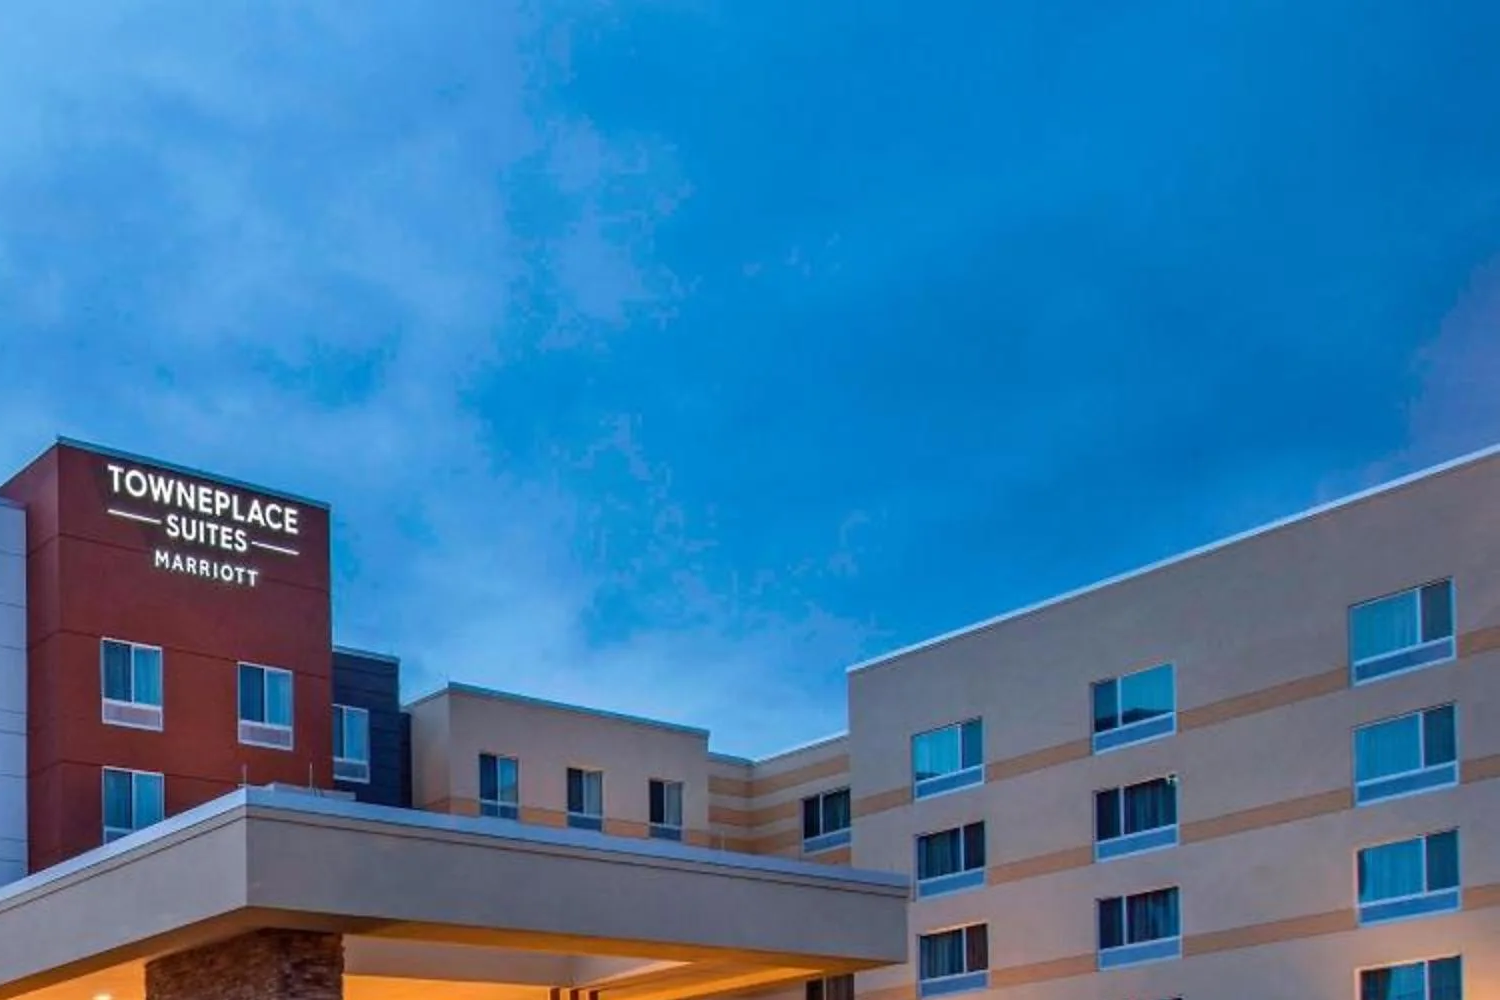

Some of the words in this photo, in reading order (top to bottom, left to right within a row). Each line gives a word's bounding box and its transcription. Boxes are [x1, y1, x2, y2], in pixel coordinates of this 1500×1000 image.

[107, 464, 299, 534] TOWNEPLACE
[166, 514, 248, 552] SUITES
[155, 550, 259, 587] MARRIOTT
